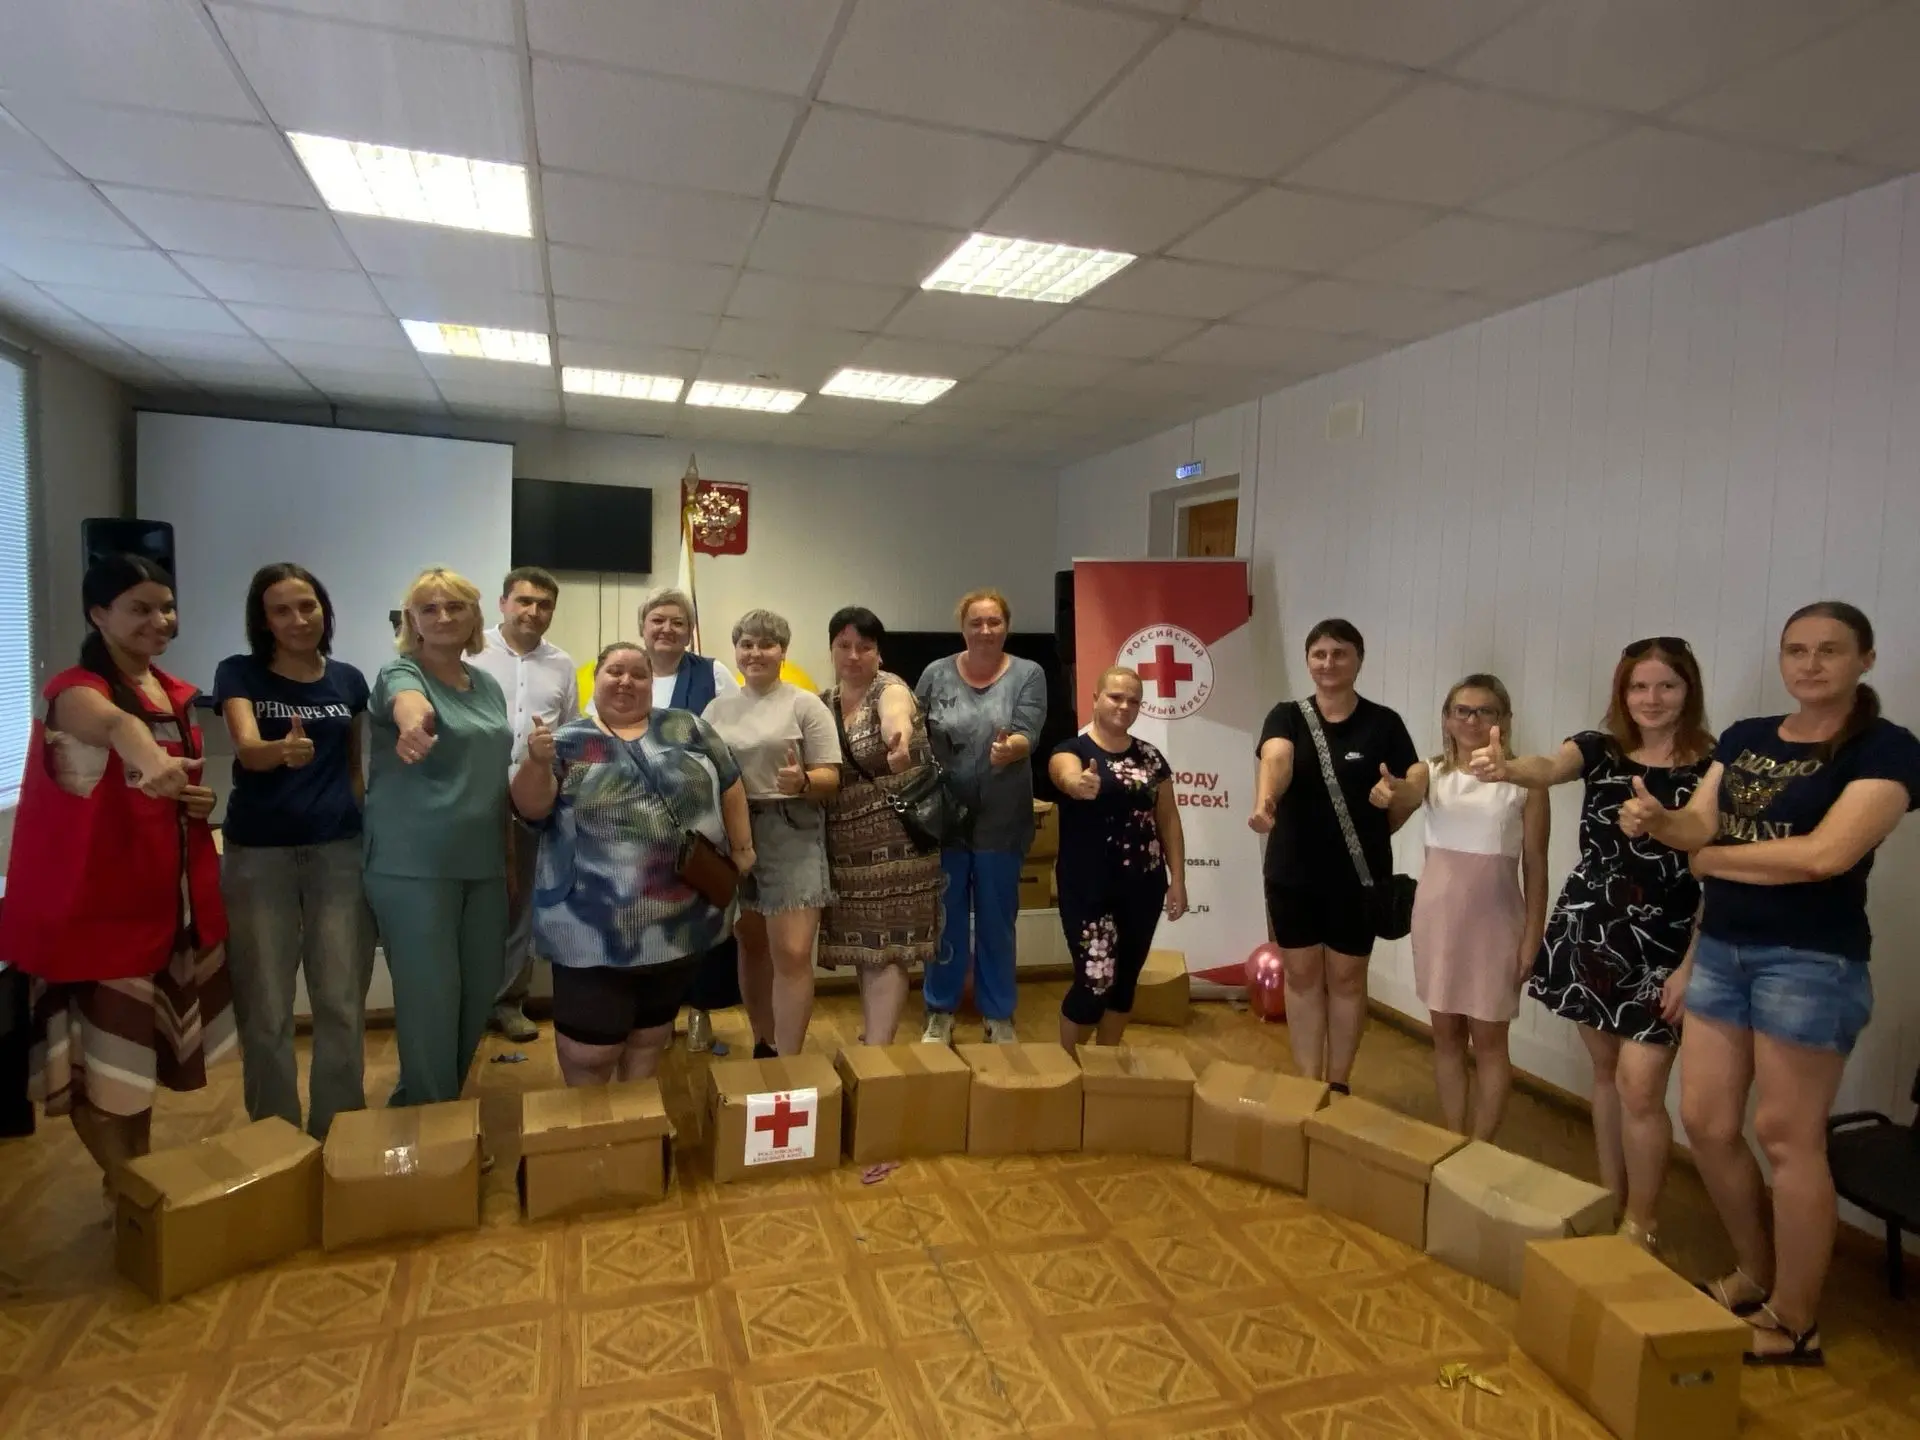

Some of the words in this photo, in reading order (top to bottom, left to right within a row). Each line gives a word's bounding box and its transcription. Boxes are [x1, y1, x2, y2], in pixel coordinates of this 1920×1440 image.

[1126, 628, 1204, 658] РОССИЙСКИЙ
[1140, 700, 1176, 715] СНЫЙ
[1180, 682, 1208, 713] КРЕСТ
[1177, 790, 1230, 809] всех!
